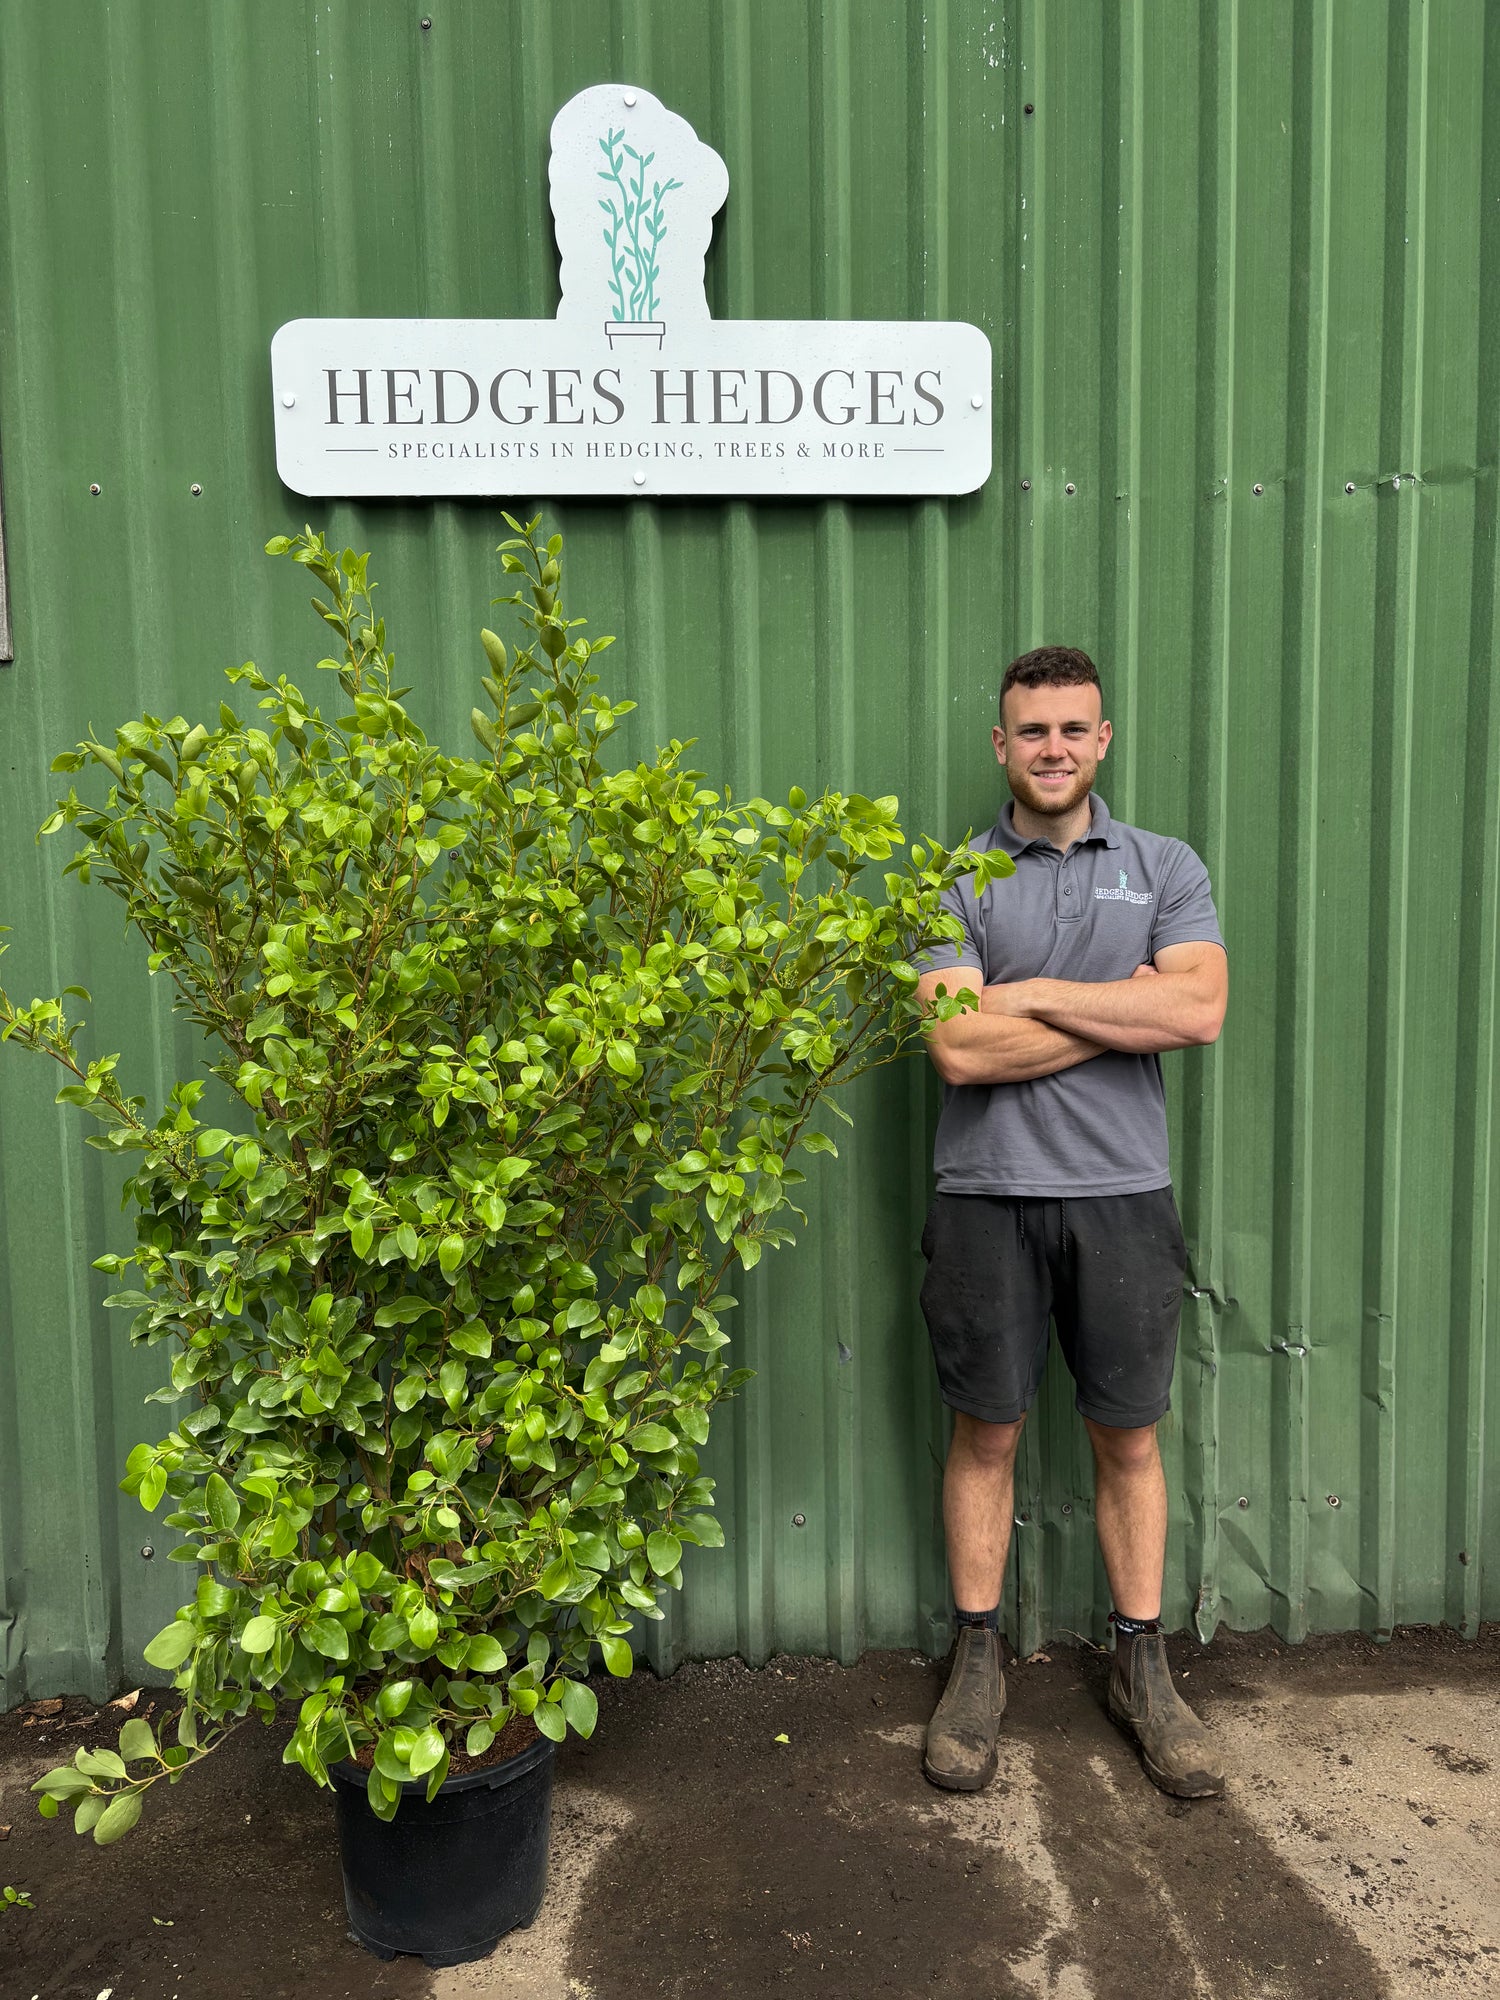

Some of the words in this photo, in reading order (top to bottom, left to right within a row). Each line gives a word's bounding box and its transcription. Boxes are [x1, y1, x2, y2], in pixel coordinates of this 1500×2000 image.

[322, 368, 625, 426] HEDGES
[650, 369, 945, 427] HEDGES
[388, 442, 539, 459] SPECIALISTS
[551, 442, 573, 458] IN
[587, 442, 703, 461] HEDGING,
[715, 442, 785, 458] TREES
[797, 442, 810, 458] &
[823, 442, 885, 458] MORE
